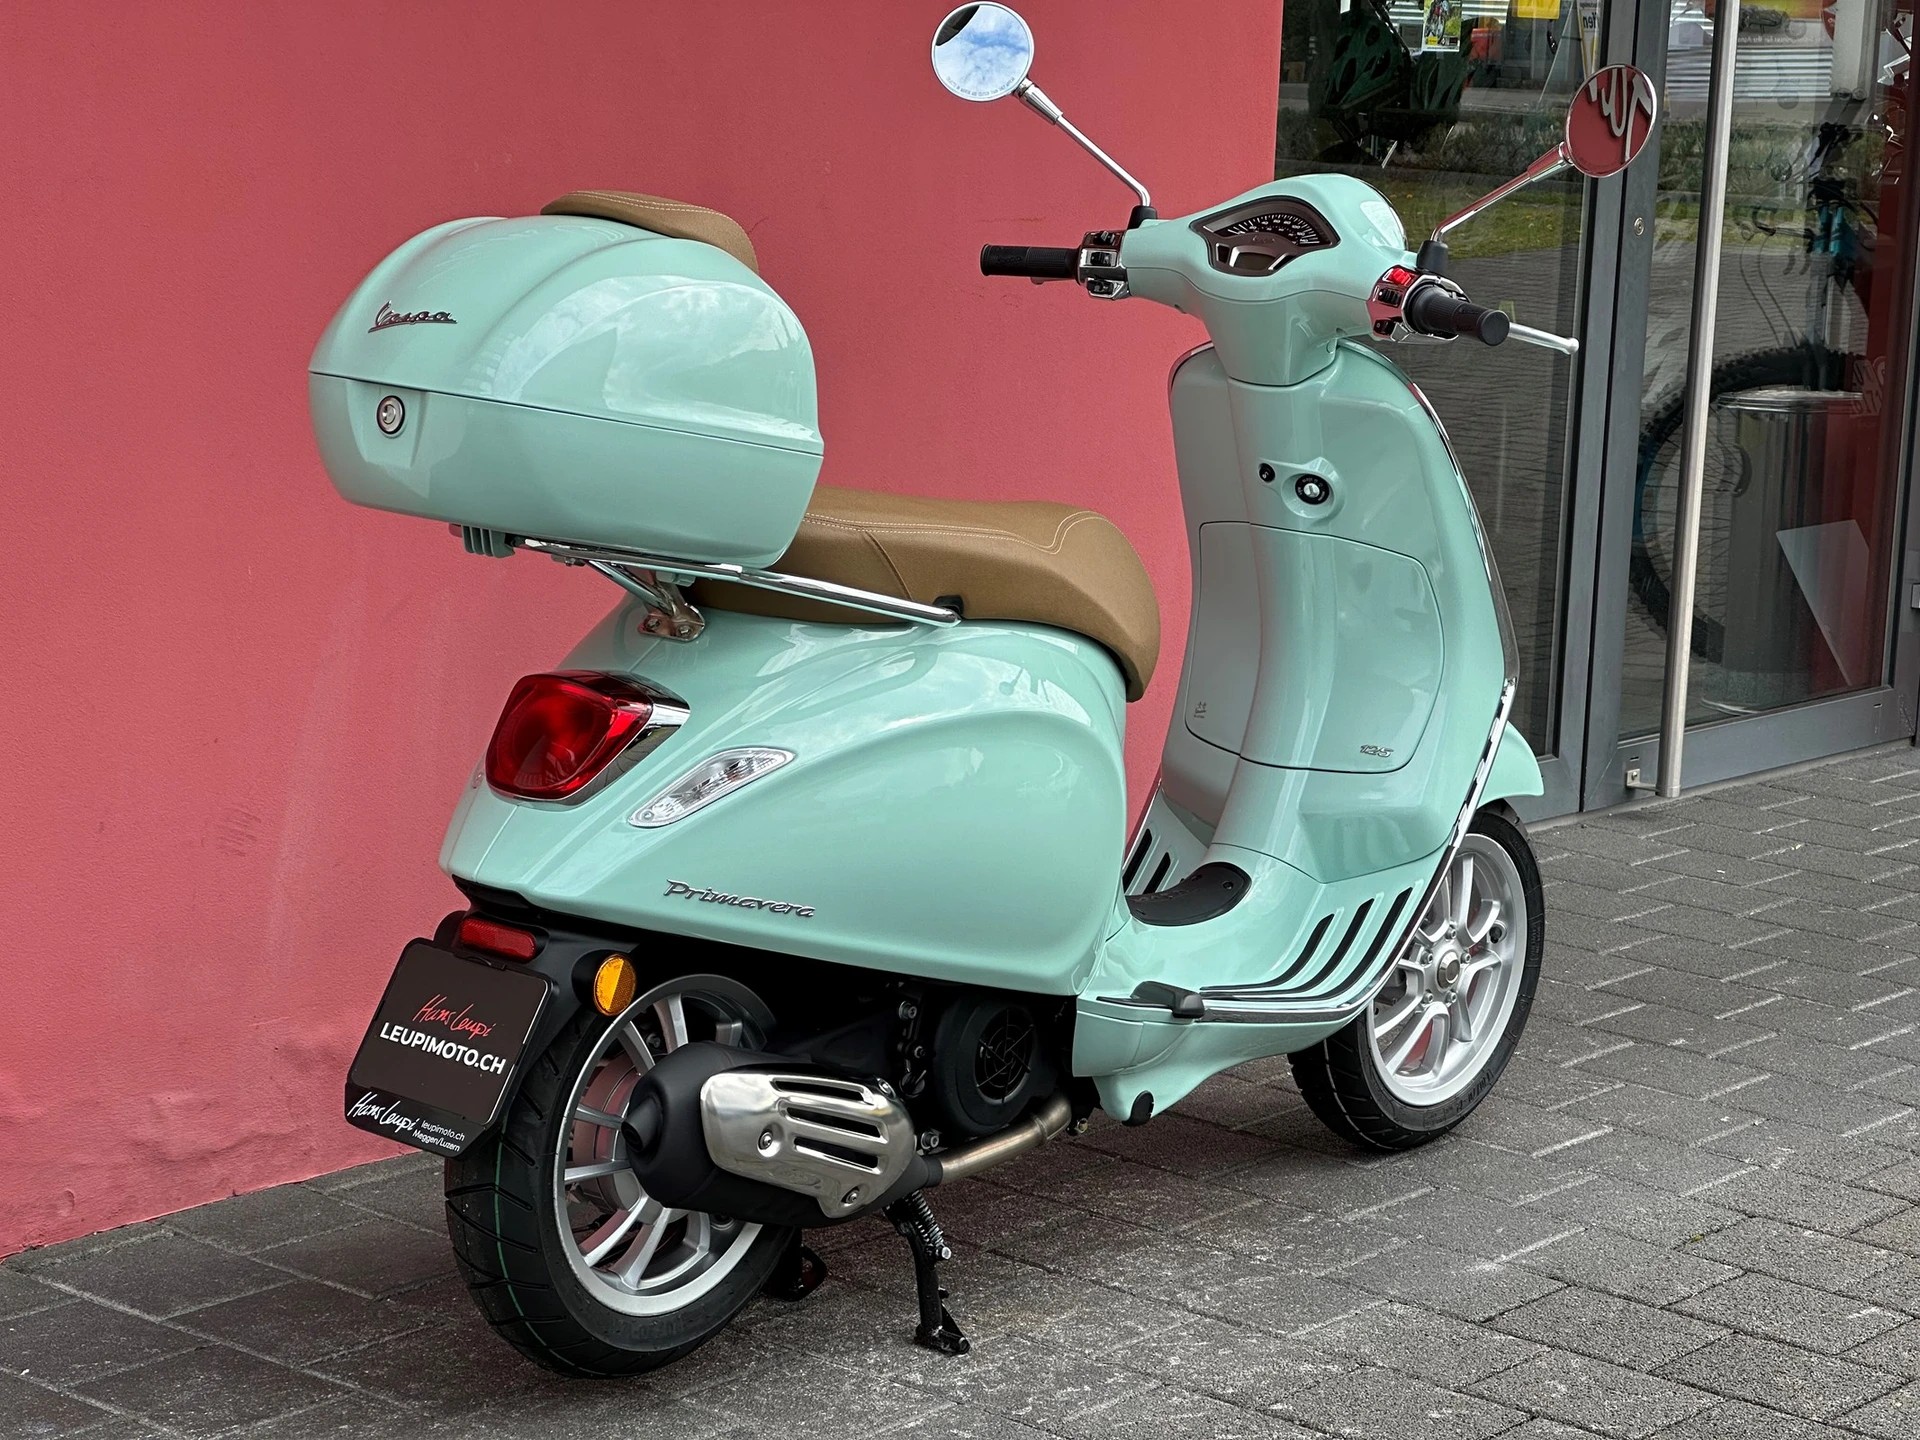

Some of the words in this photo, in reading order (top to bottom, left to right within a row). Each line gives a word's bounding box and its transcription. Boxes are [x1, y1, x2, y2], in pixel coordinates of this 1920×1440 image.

[367, 300, 458, 333] Vespa
[1360, 744, 1395, 758] 125
[663, 878, 816, 918] Primavera
[412, 994, 456, 1025] Hans
[450, 1003, 496, 1040] Leupi
[380, 1022, 507, 1075] LEUPIMOTO.CH
[347, 1091, 386, 1119] Hans
[379, 1100, 419, 1134] Leupi
[420, 1119, 464, 1142] leupimoto.ch
[412, 1129, 461, 1152] Meggen/Luzern
